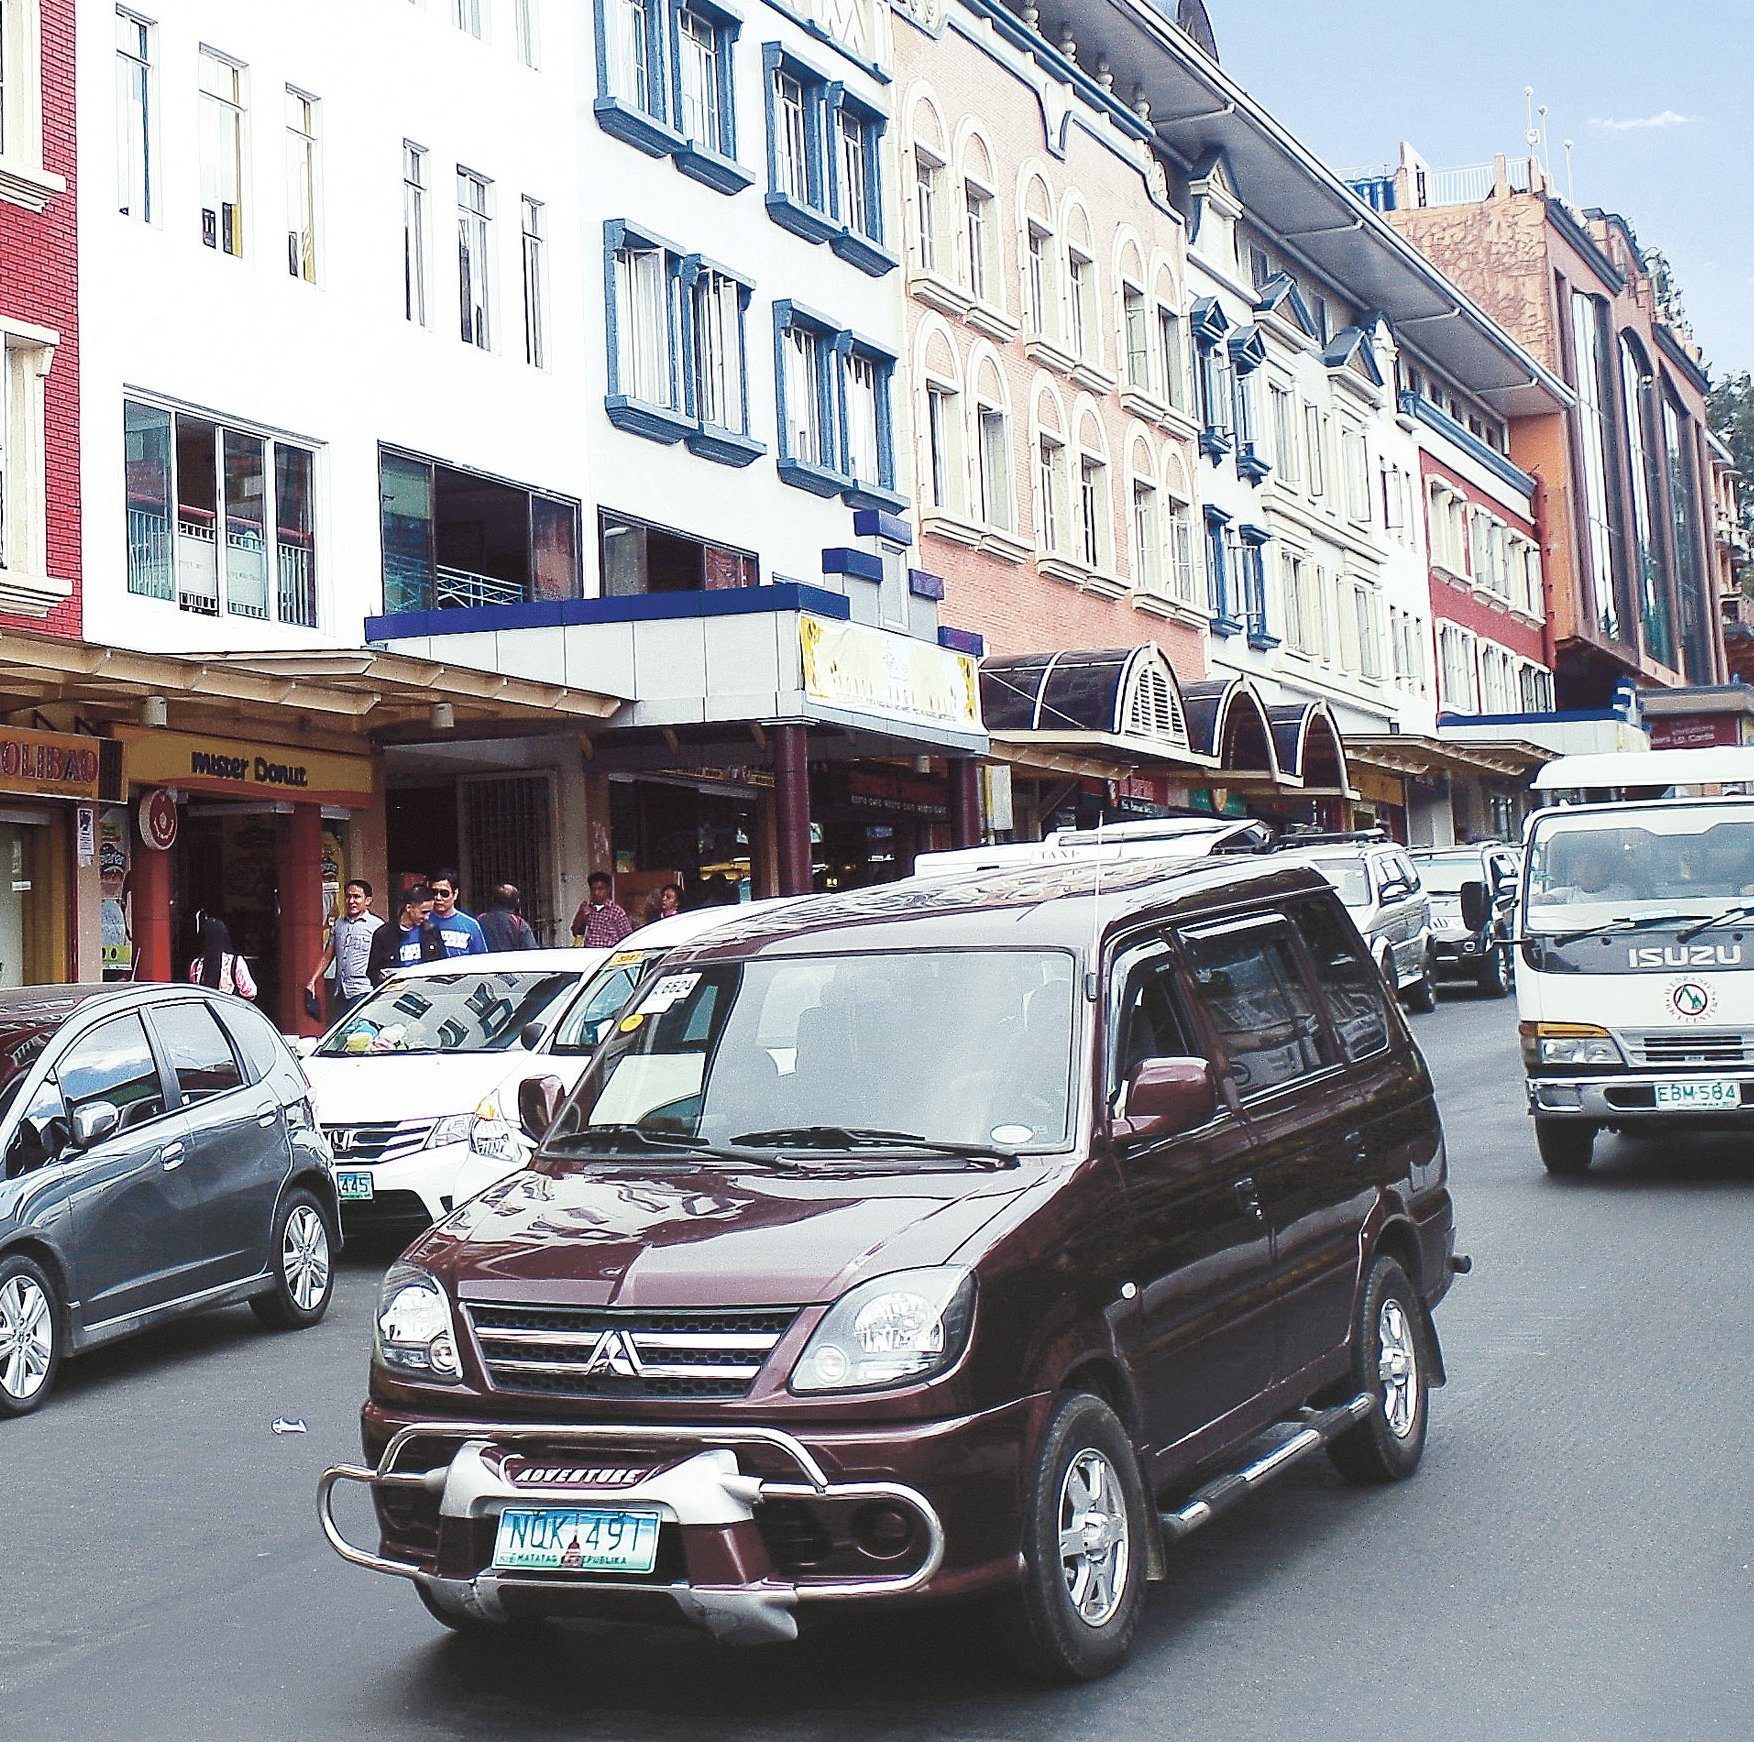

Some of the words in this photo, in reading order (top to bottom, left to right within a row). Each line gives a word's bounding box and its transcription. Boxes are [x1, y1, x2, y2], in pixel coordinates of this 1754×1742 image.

[254, 756, 308, 787] Donut
[1628, 945, 1742, 968] ISUZU
[514, 1467, 645, 1484] ADVENTURE
[509, 1514, 571, 1549] NQK
[585, 1515, 641, 1551] 491
